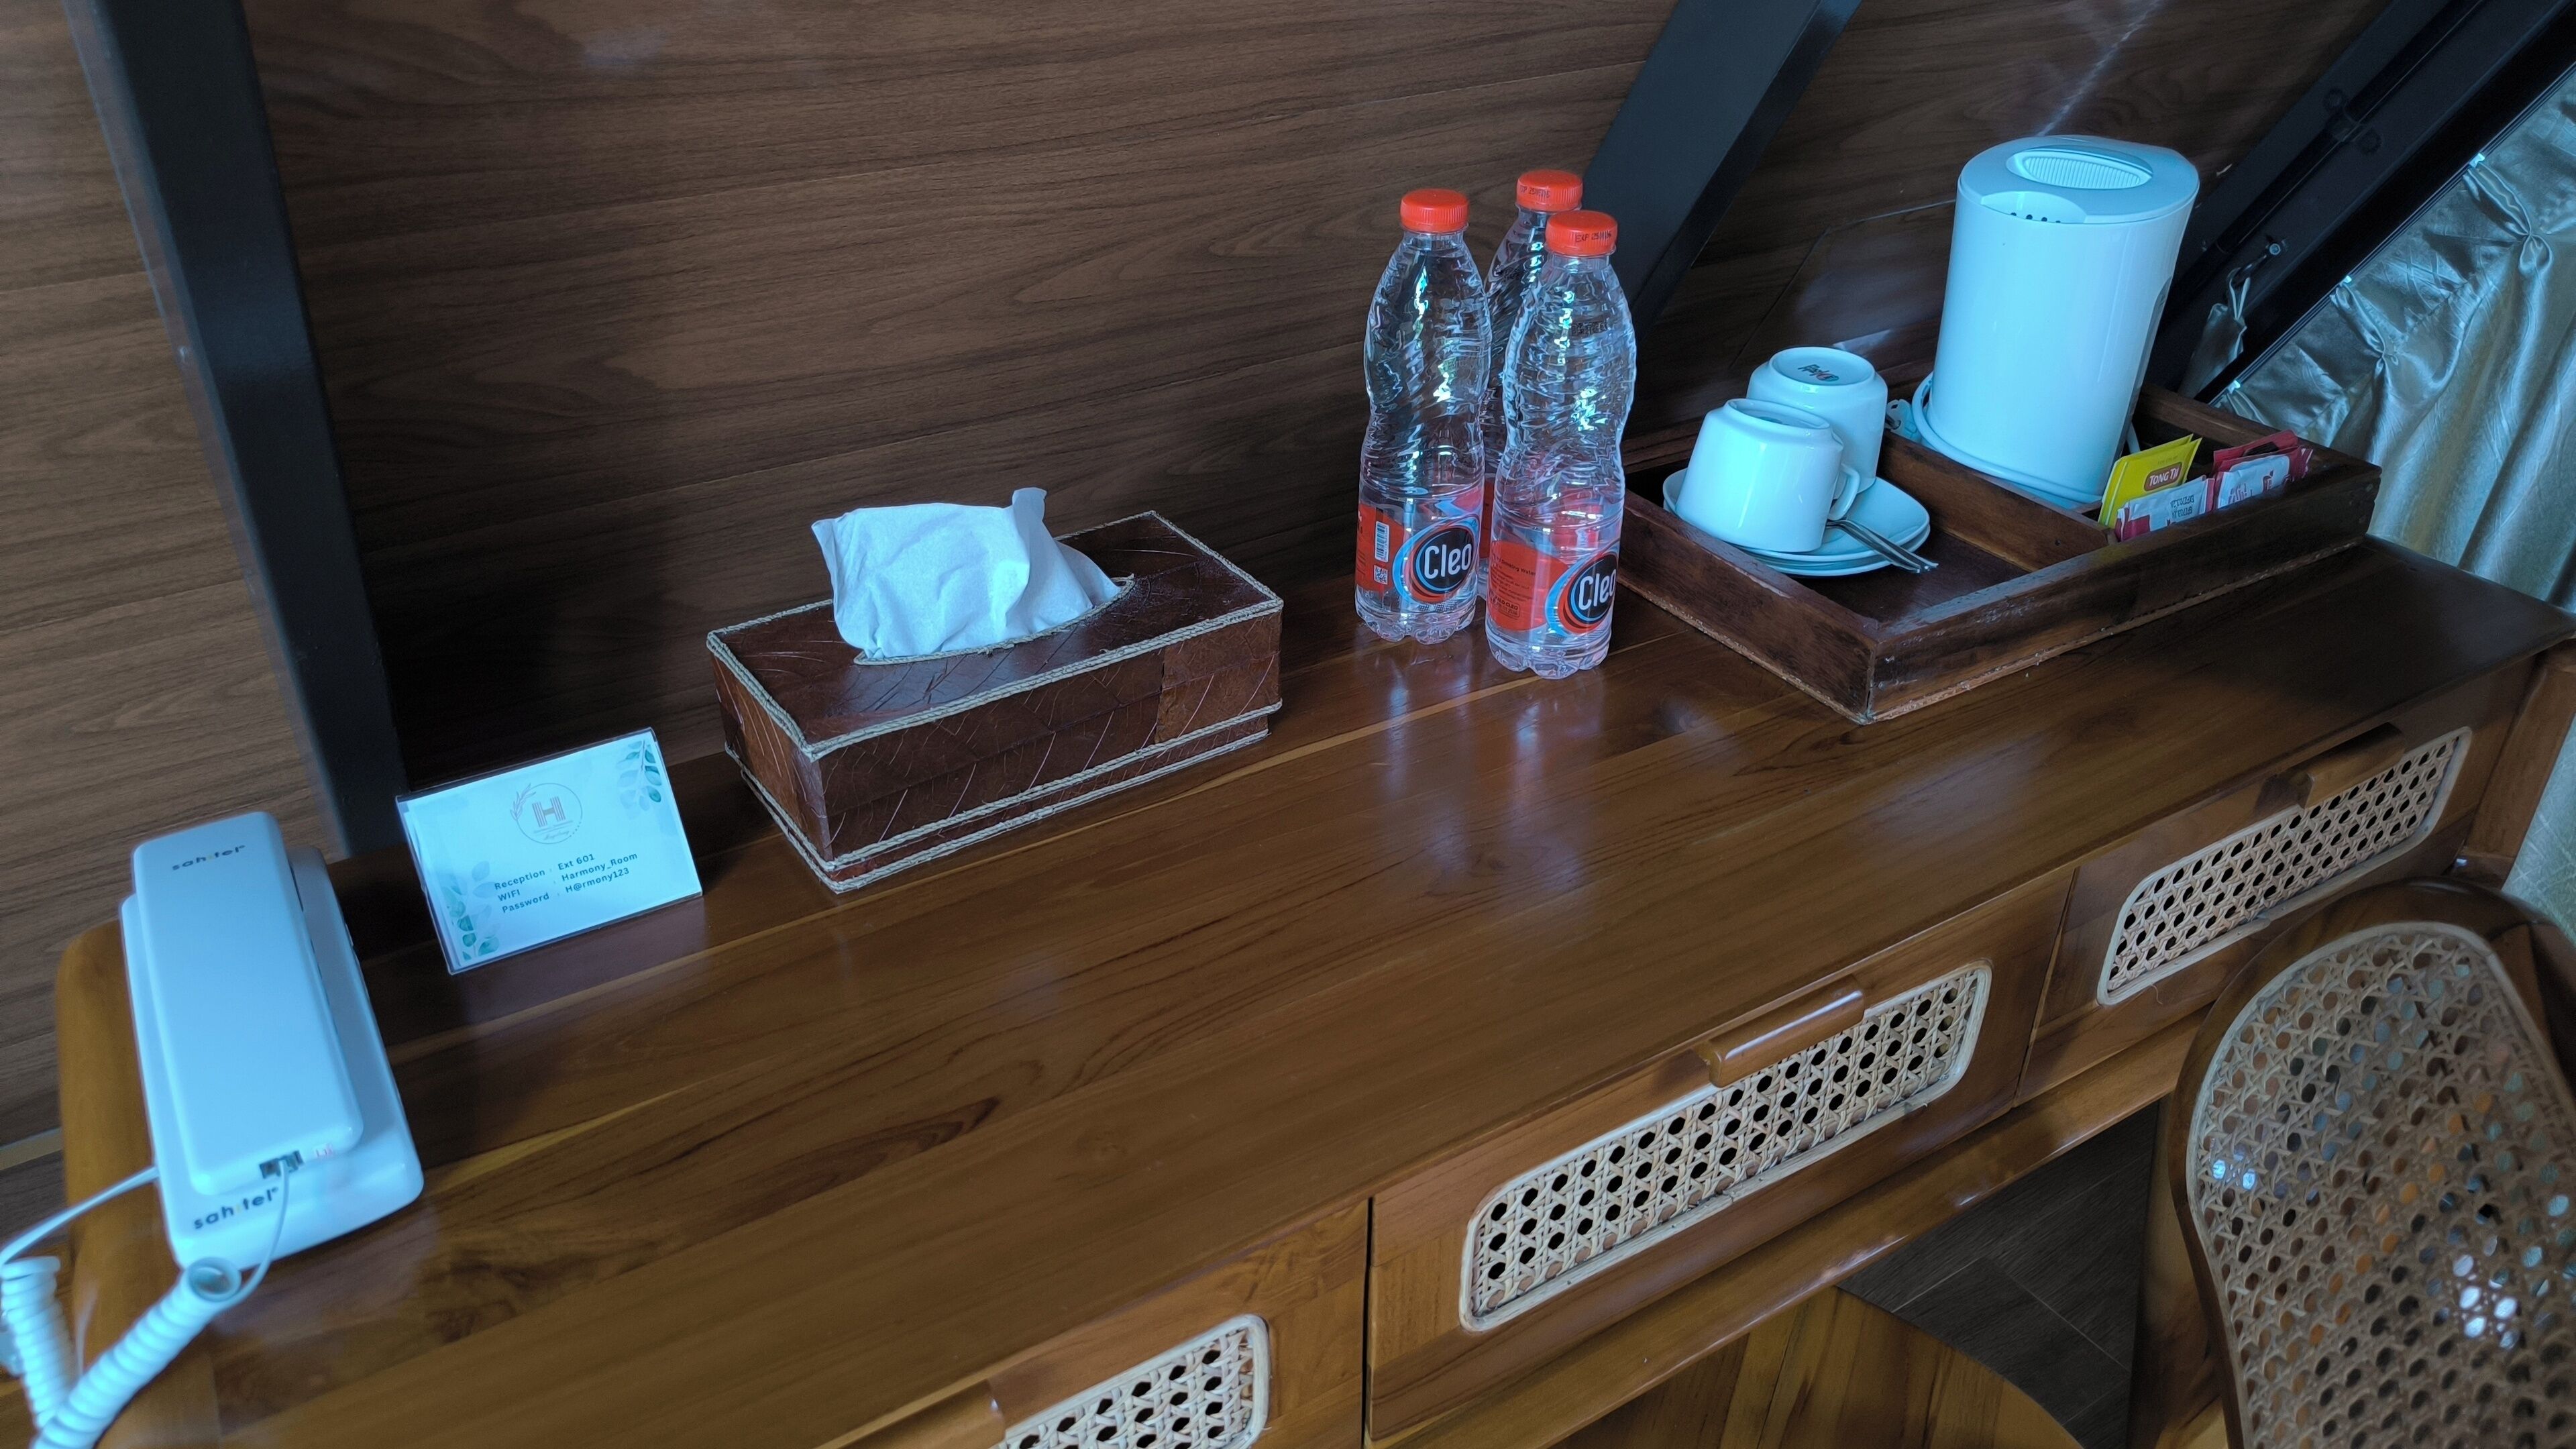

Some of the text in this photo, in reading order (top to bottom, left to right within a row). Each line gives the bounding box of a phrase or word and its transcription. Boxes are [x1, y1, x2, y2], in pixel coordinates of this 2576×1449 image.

[2149, 472, 2170, 487] TONG
[1424, 543, 1472, 580] Cleo
[1578, 568, 1617, 610] Cleo
[494, 853, 595, 891] Reception Ext 601
[498, 853, 638, 902] WIFI Harmony_Room
[502, 867, 630, 914] Password H@rmony123
